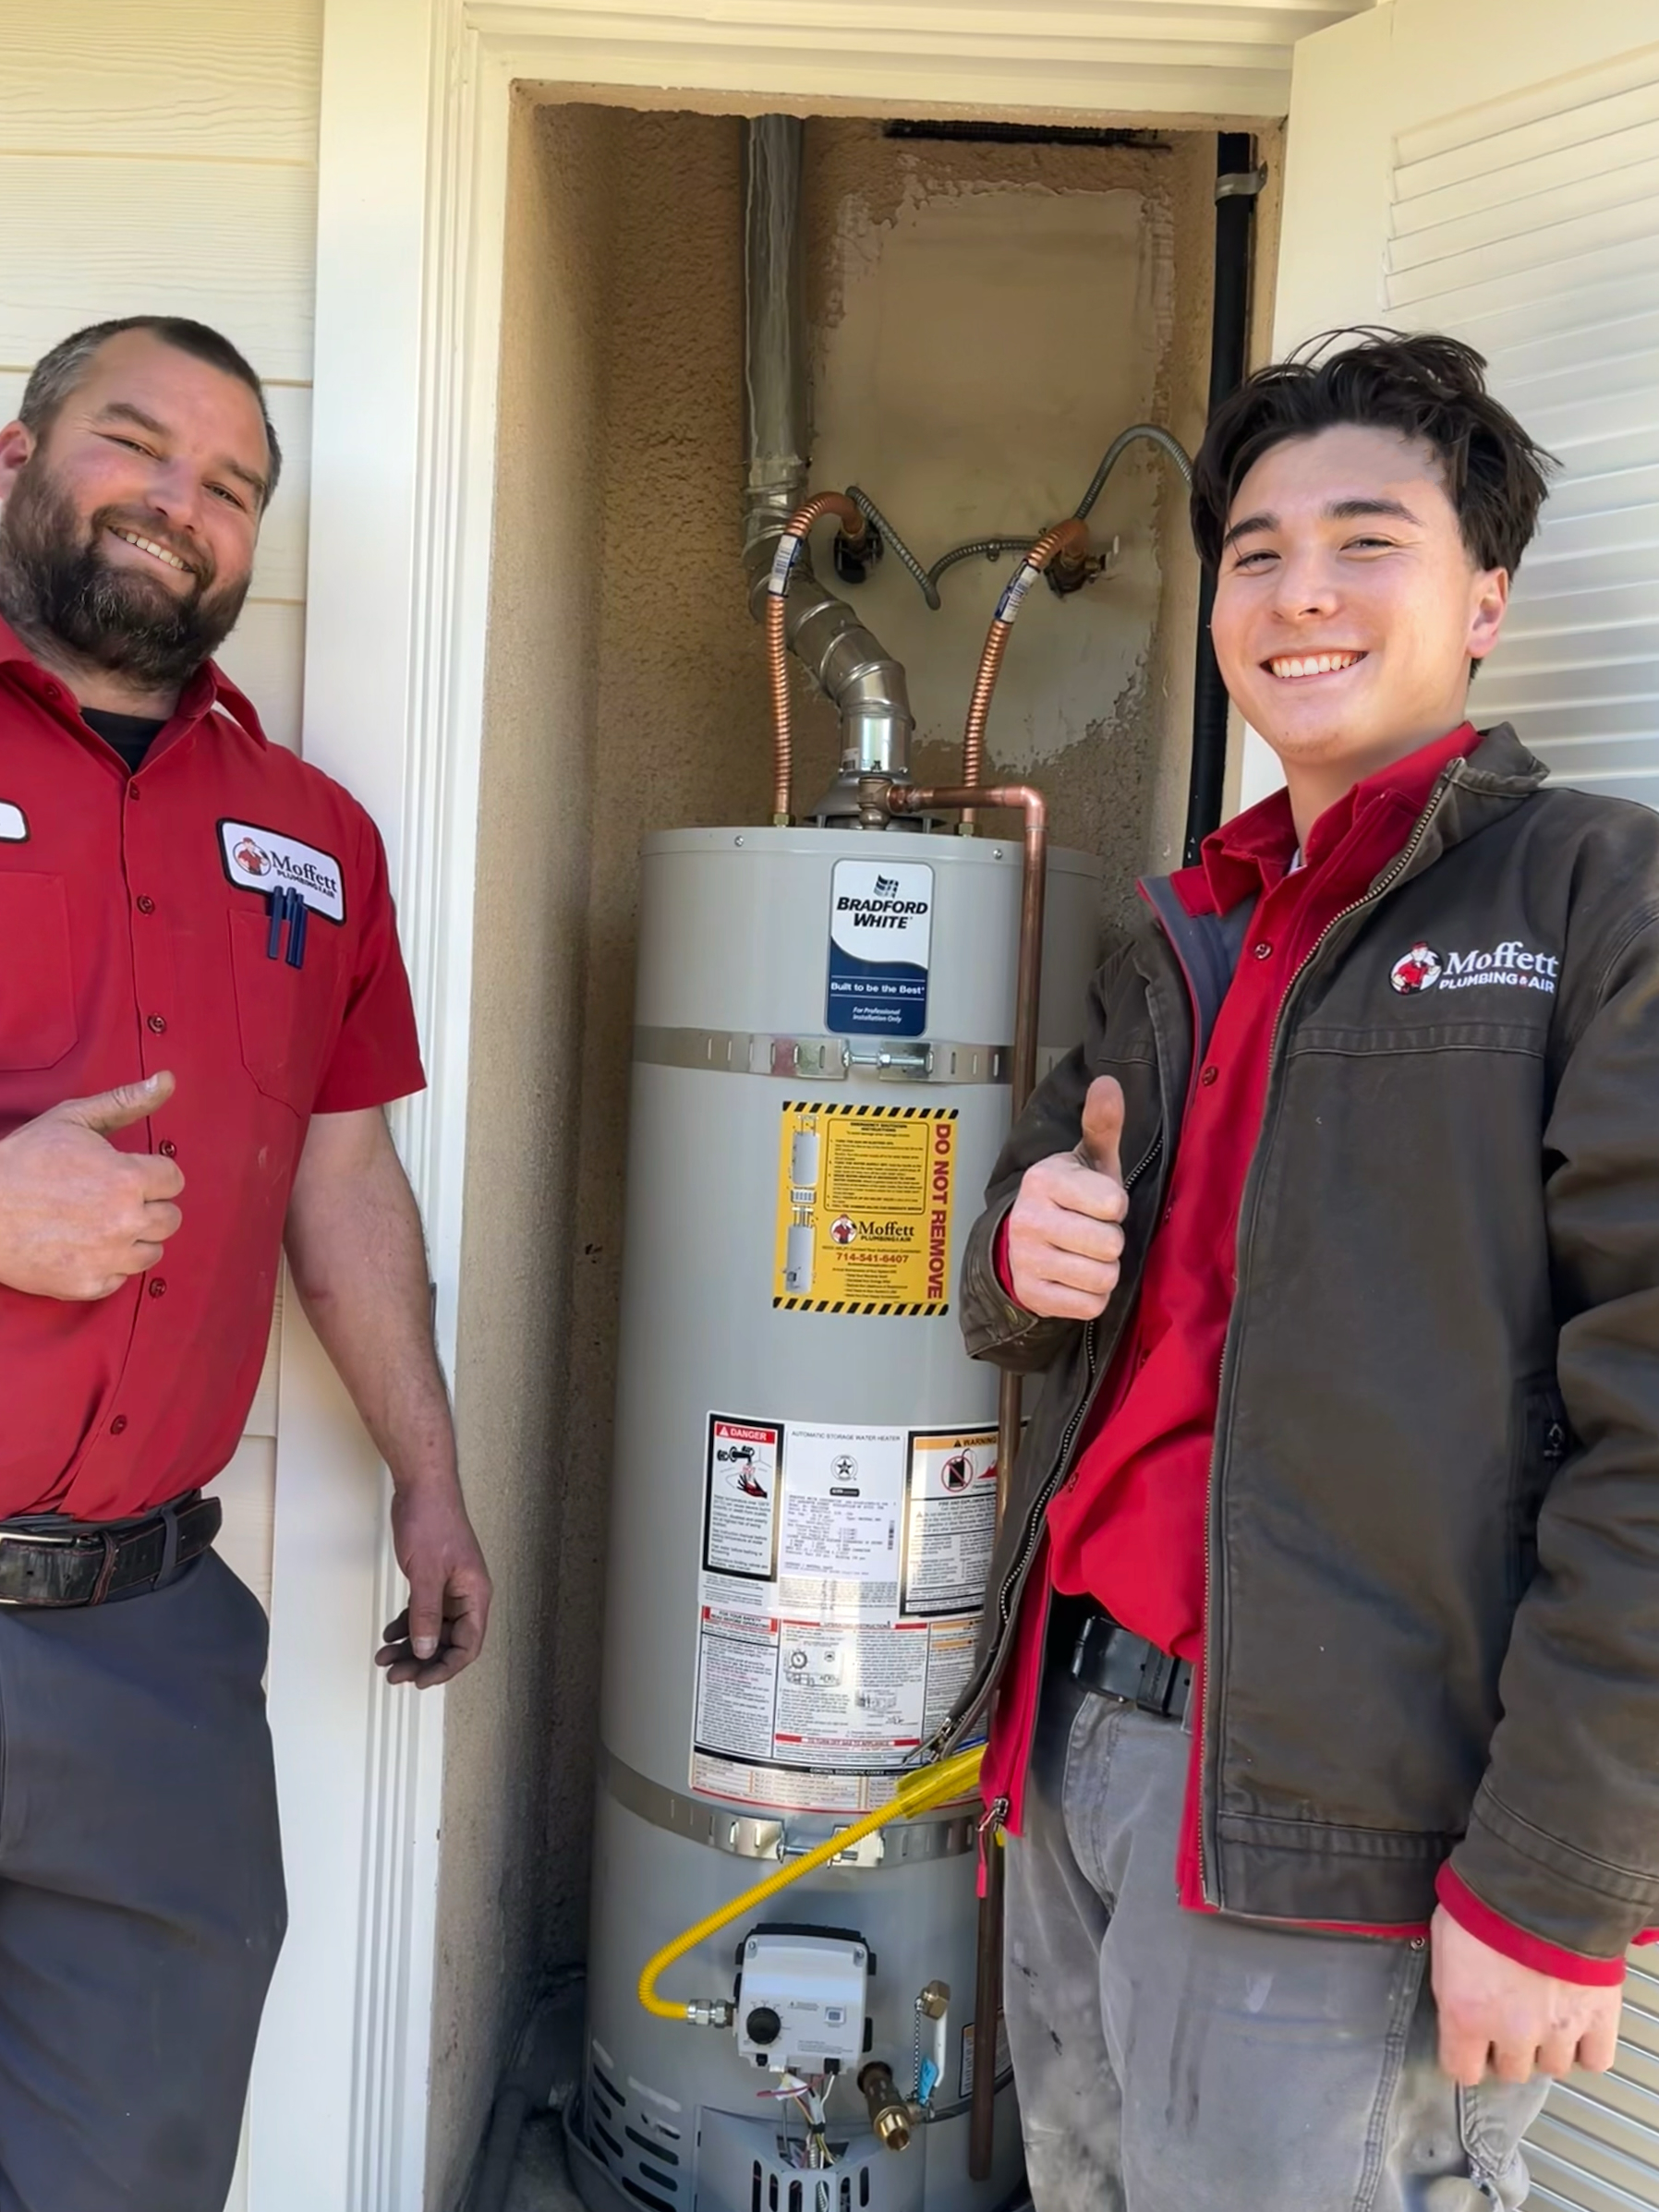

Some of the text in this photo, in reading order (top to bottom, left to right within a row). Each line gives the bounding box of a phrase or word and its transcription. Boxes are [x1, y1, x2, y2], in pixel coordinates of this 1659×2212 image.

[270, 850, 337, 892] Moffett
[836, 897, 928, 914] BRADFORD
[854, 913, 909, 929] WHITE
[1442, 941, 1559, 977] Moffett
[830, 982, 852, 991] Built
[854, 983, 865, 992] to
[866, 984, 879, 993] be
[881, 985, 897, 994] the
[1438, 972, 1518, 990] PLUMBING
[1528, 976, 1555, 994] AIR
[864, 1007, 902, 1015] Professional
[853, 1014, 902, 1024] Installation Only
[927, 1124, 951, 1299] DO NOT REMOVE
[858, 1220, 914, 1237] Moffett
[836, 1252, 910, 1263] 714-541-6407
[730, 1428, 768, 1441] DANGER
[792, 1431, 825, 1439] AUTOMATIC
[963, 1436, 997, 1446] WARNING
